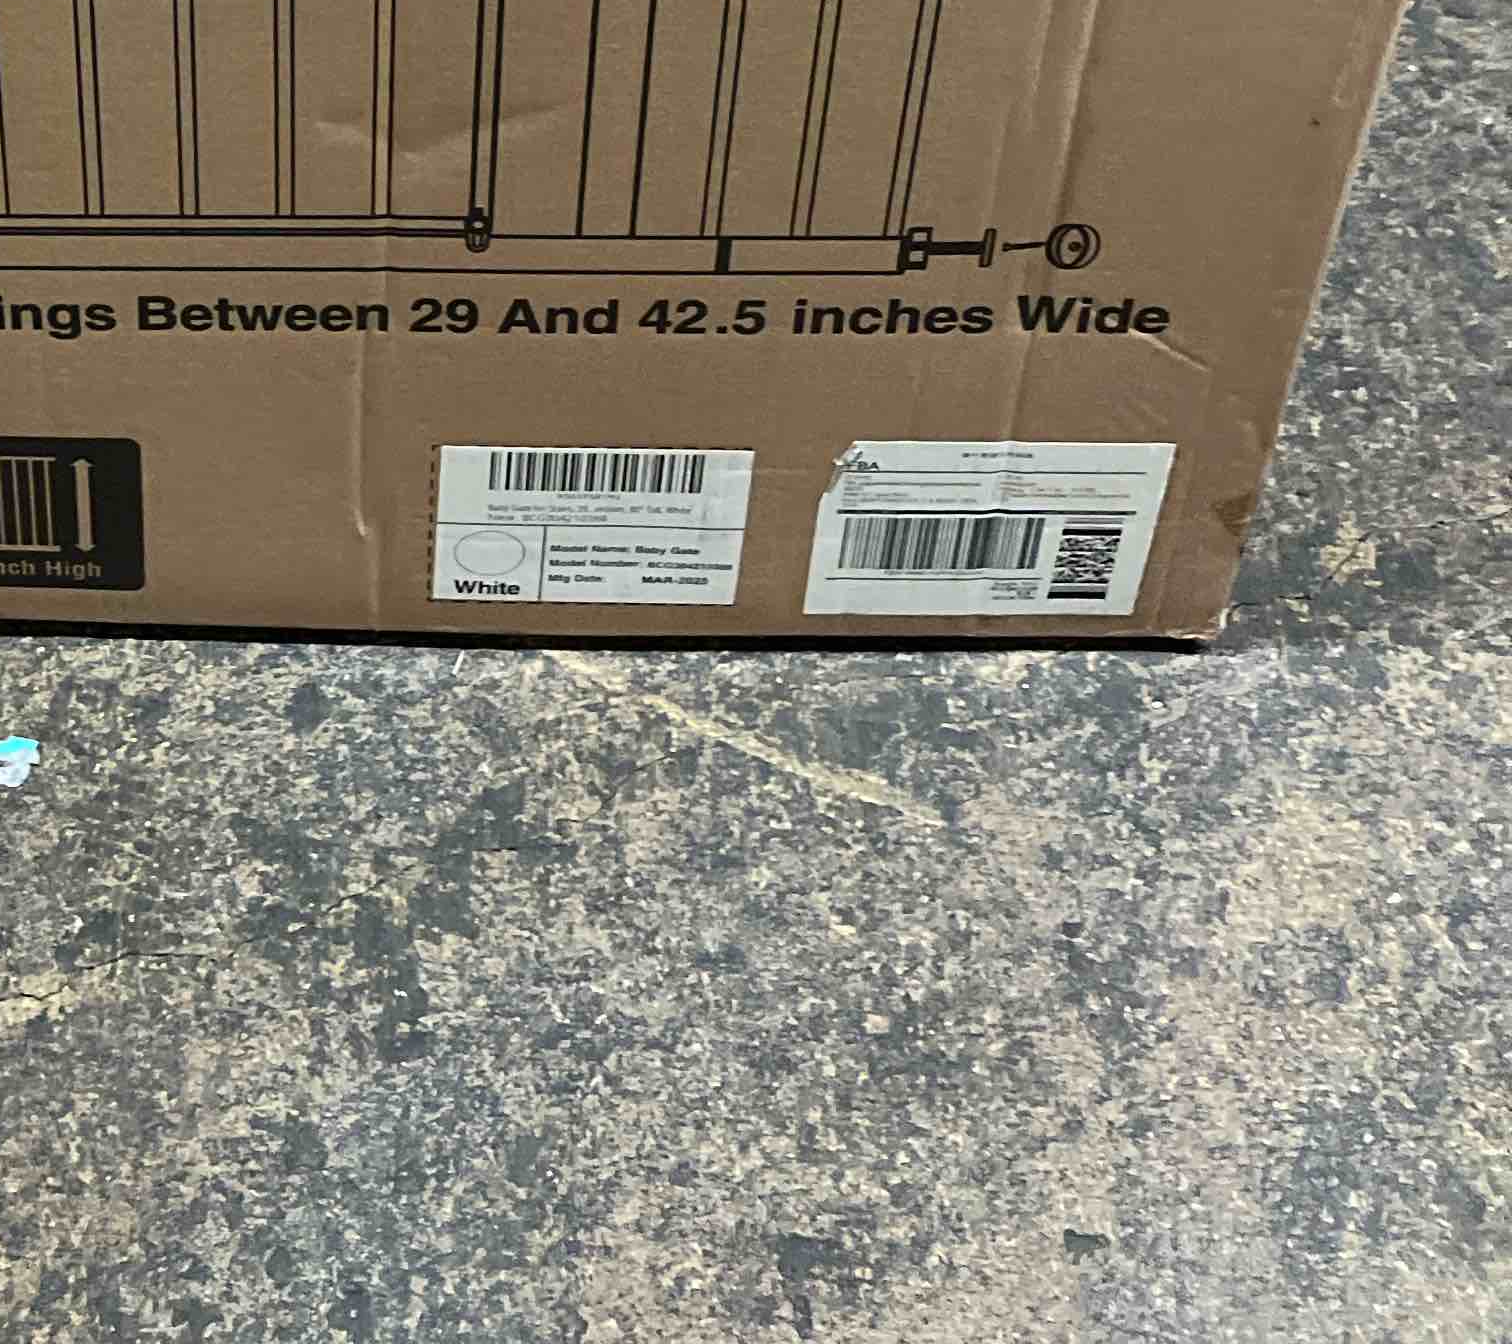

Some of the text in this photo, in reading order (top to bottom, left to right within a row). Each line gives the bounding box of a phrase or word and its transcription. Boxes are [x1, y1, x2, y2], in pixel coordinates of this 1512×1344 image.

[137, 295, 390, 333] Between
[409, 297, 479, 334] 29
[497, 298, 620, 335] And
[638, 299, 767, 335] 42.5
[792, 296, 994, 335] inches
[1016, 294, 1171, 335] Wide
[45, 559, 103, 581] High
[453, 580, 521, 597] White
